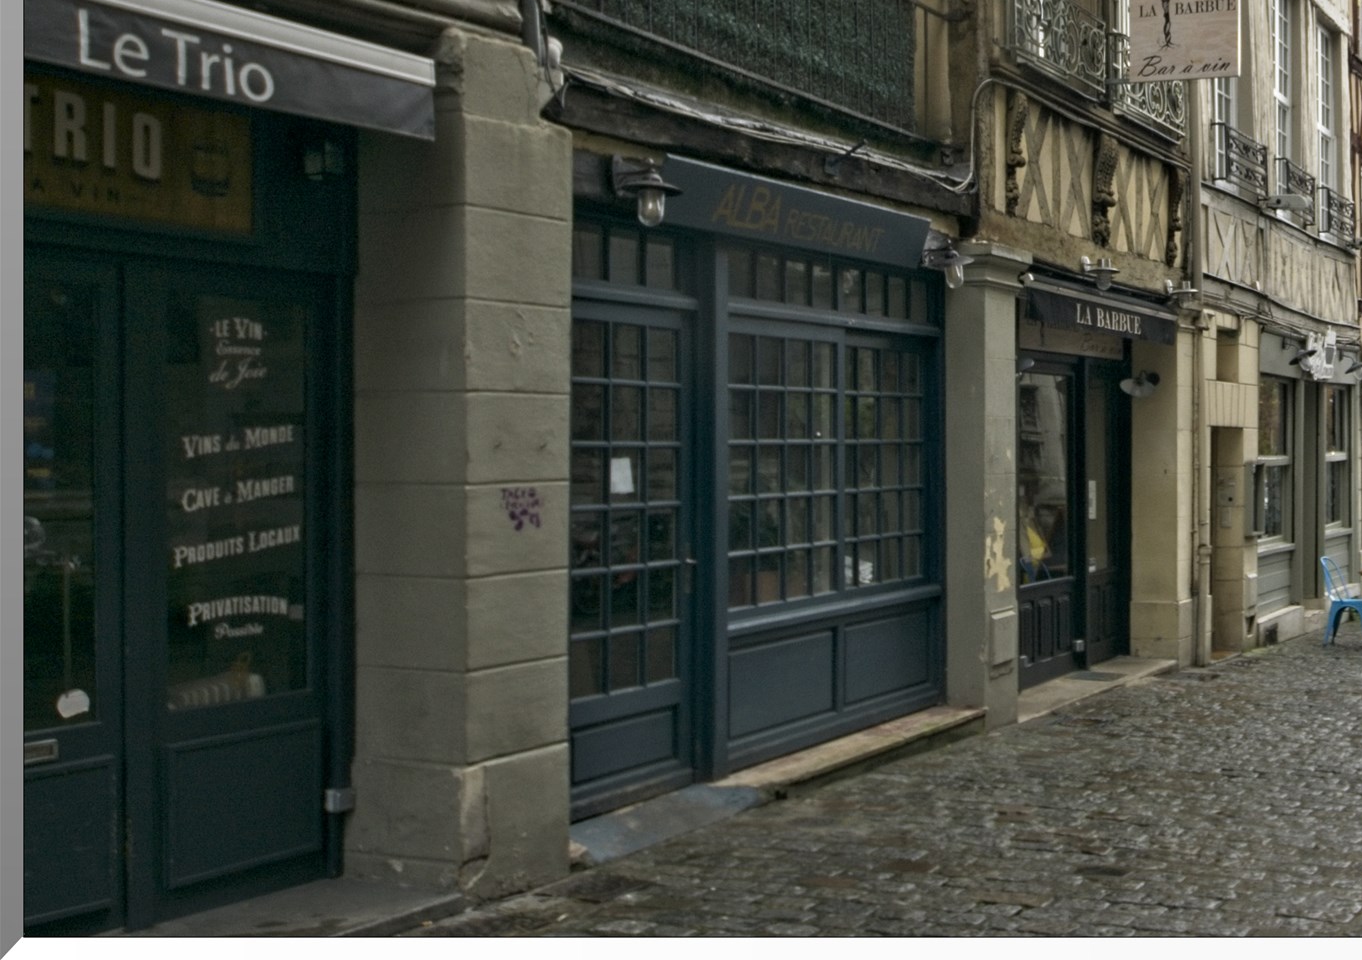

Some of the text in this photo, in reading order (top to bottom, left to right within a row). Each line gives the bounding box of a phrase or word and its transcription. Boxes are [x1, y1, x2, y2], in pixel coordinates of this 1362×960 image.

[1139, 5, 1156, 17] LA
[78, 8, 275, 104] Le Trio
[1137, 55, 1231, 77] Bar à vin
[711, 183, 886, 254] ALBA RESTAURANT
[215, 318, 263, 341] LE VIN
[1076, 303, 1142, 335] LA BARBUE
[181, 434, 222, 458] VINS
[244, 425, 295, 451] MONDE
[181, 487, 221, 513] CAVE
[236, 476, 295, 504] MANGER
[173, 525, 302, 570] PRODUITS LOCAUX
[187, 596, 288, 628] PRIVATISATION
